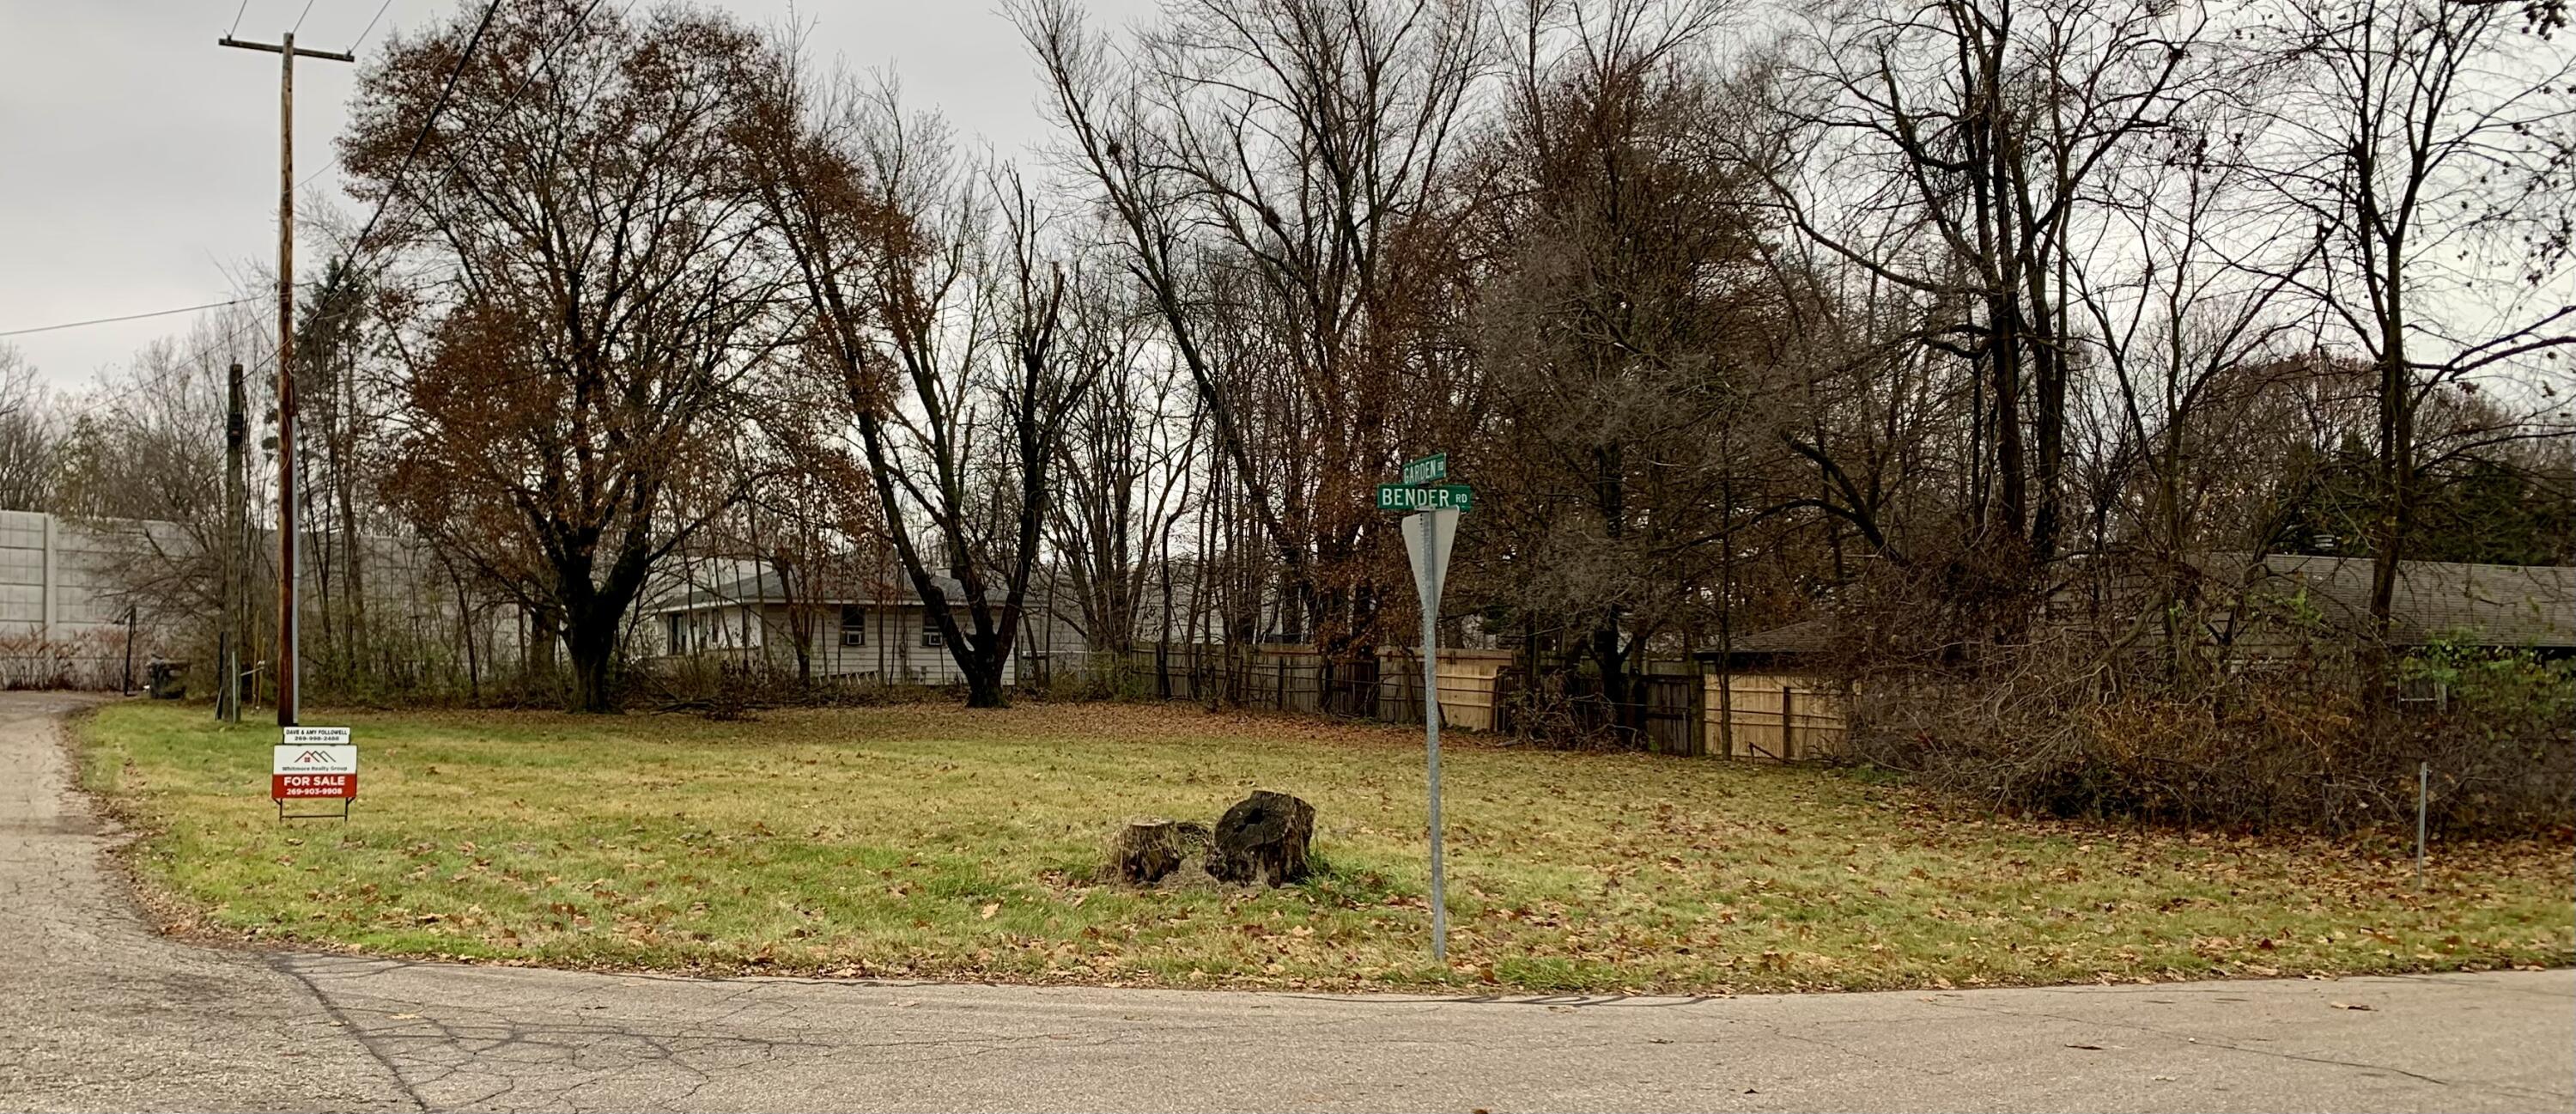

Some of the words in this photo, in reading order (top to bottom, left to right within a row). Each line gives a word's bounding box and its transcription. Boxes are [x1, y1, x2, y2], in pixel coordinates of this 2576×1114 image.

[1404, 460, 1437, 484] GARDEN
[1382, 488, 1449, 508] BENDER
[1455, 493, 1467, 503] RD
[283, 776, 310, 786] FOR
[313, 776, 345, 786] SALE
